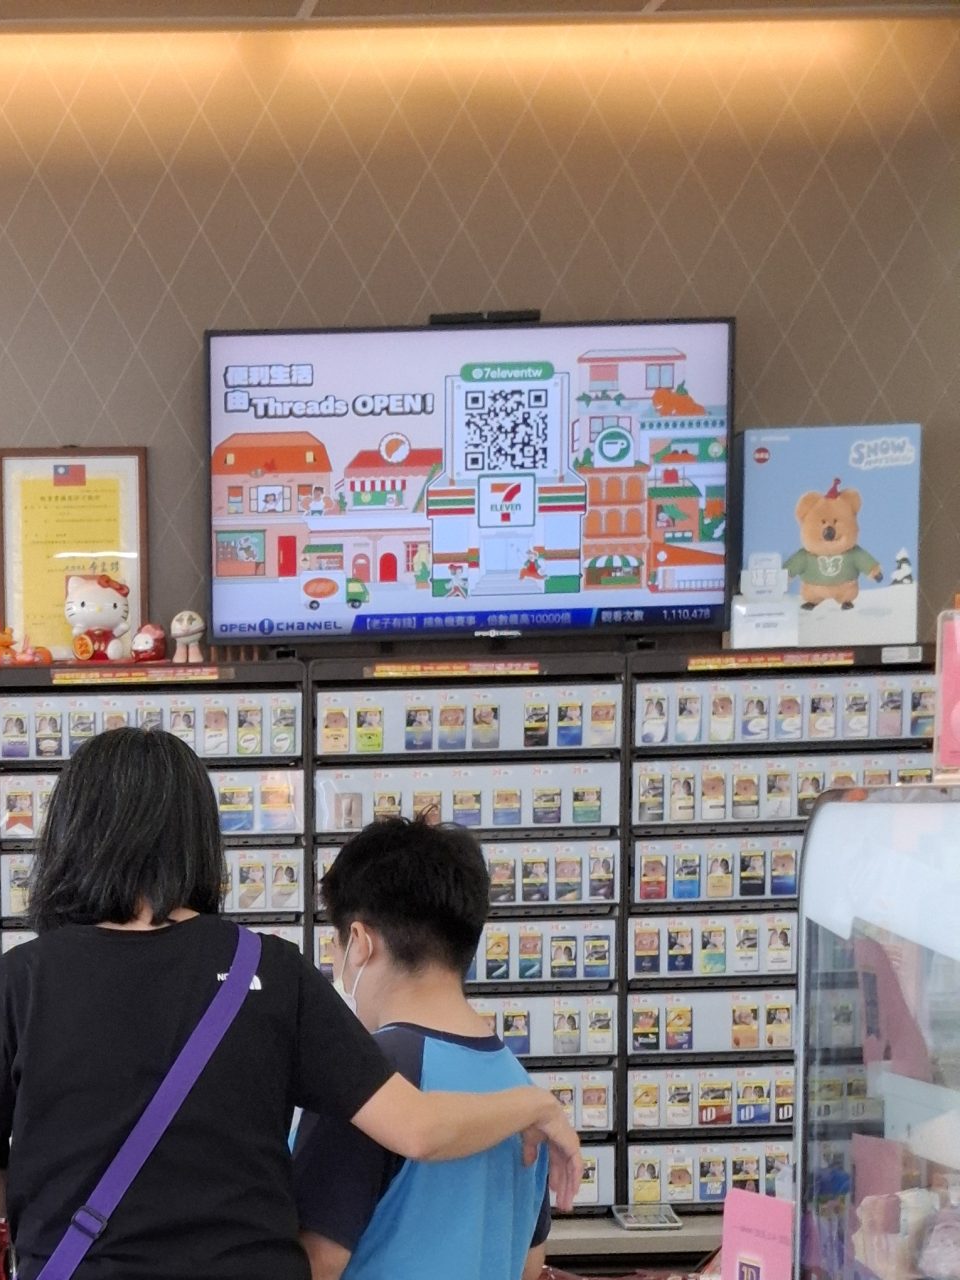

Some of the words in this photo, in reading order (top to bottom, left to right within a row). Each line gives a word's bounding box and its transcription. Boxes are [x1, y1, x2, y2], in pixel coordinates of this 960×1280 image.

[472, 367, 543, 379] @7eleventw
[251, 396, 348, 418] Threads
[353, 393, 434, 415] OPEN!
